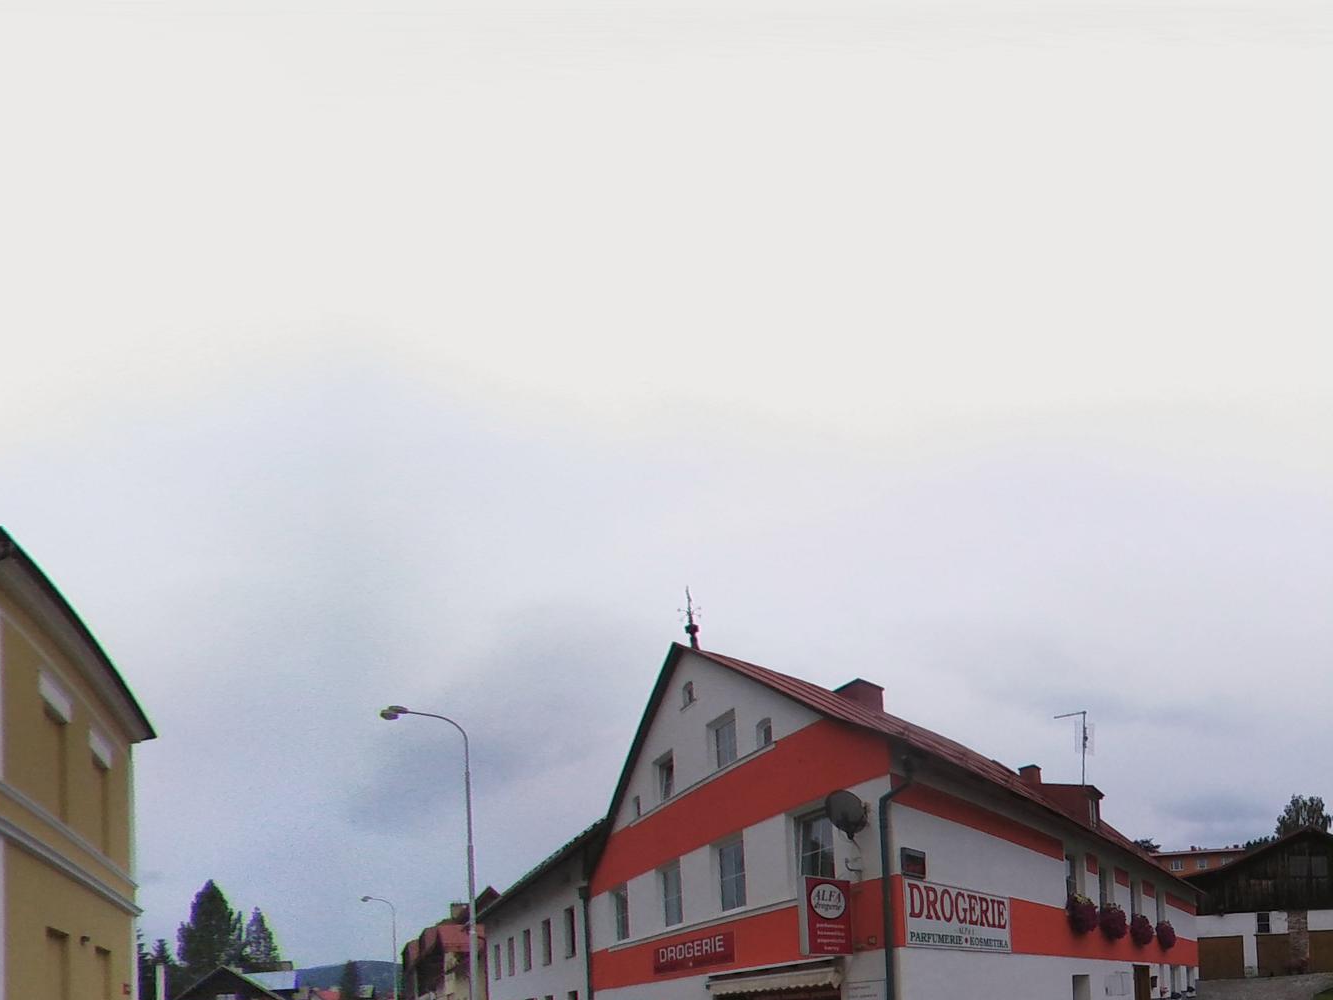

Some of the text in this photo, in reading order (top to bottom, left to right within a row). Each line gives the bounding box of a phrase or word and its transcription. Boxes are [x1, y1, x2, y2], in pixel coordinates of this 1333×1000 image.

[814, 889, 841, 903] ALFA
[814, 902, 842, 912] drogerie
[908, 882, 1007, 930] DROGERIE
[909, 931, 1008, 948] PARFUMERIE KOSMETIKA
[659, 935, 724, 963] DROGERIE
